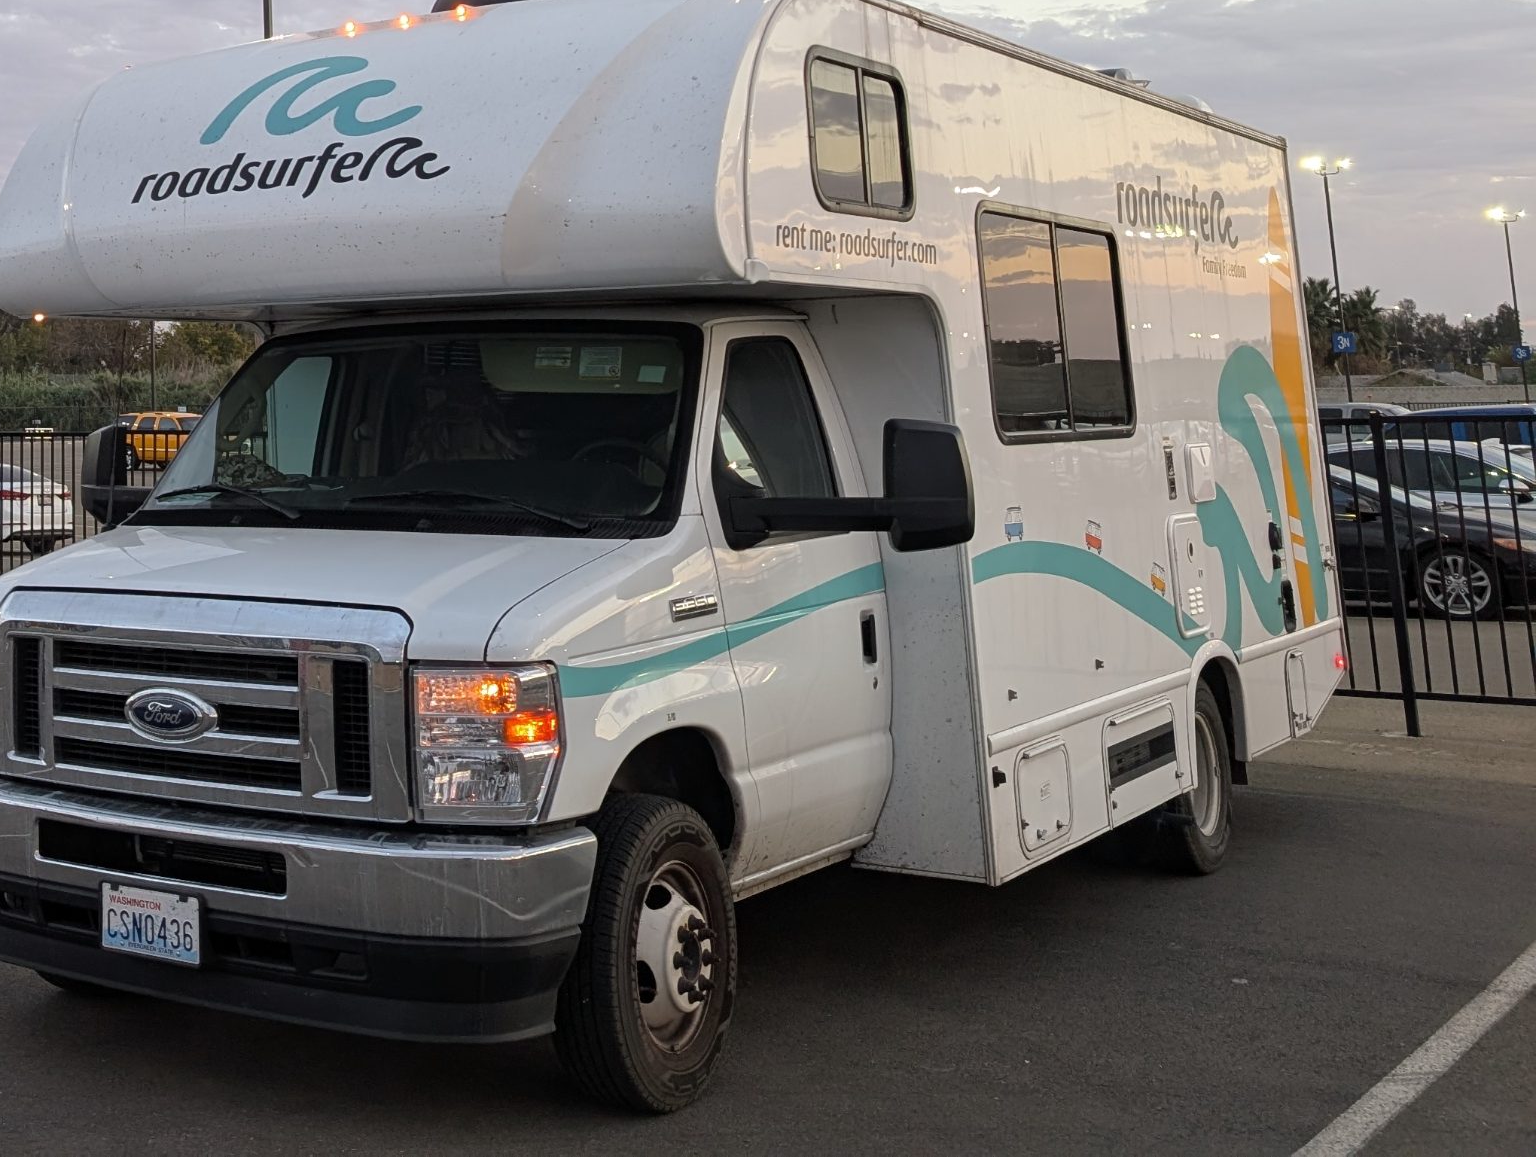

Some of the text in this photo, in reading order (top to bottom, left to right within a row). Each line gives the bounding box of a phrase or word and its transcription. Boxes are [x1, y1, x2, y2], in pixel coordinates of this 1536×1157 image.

[776, 223, 937, 267] rent me: roadsurfer.com
[1337, 335, 1350, 350] 3N
[143, 701, 182, 725] Ford
[109, 894, 161, 911] WASHINGTON
[107, 908, 194, 952] CSN0436
[158, 947, 174, 956] STATE
